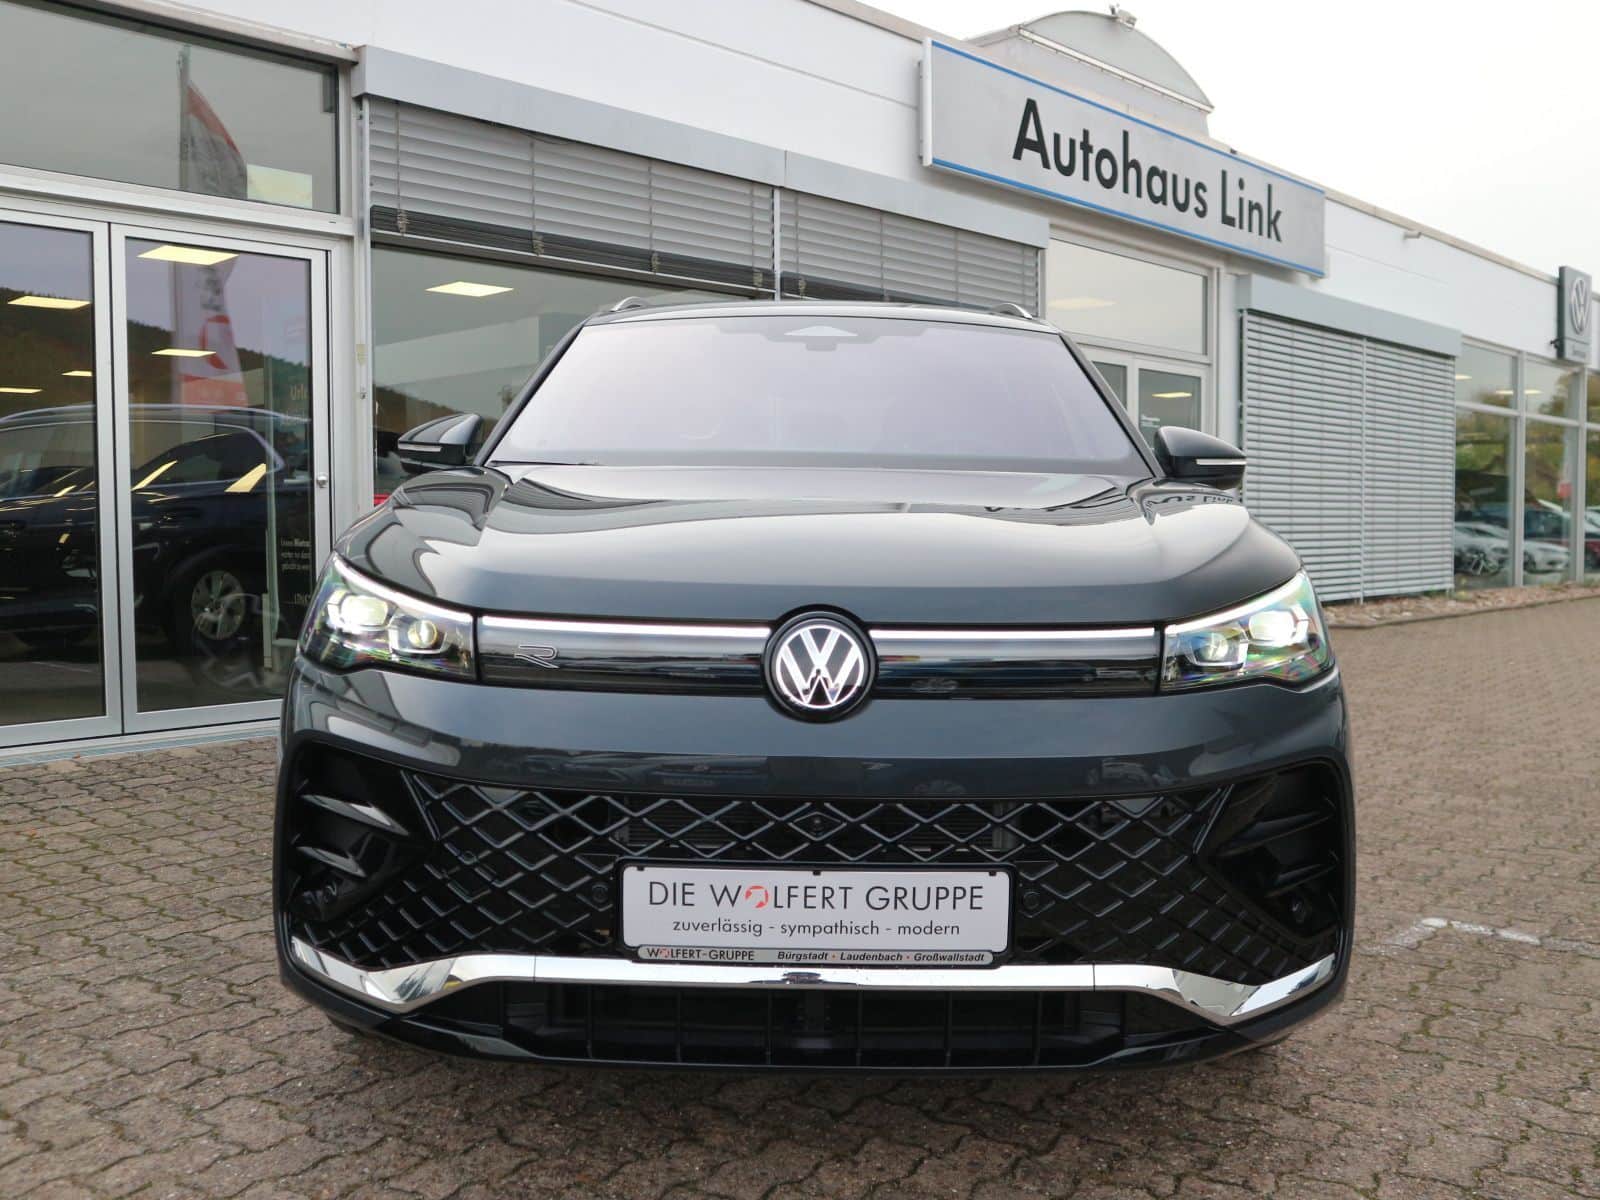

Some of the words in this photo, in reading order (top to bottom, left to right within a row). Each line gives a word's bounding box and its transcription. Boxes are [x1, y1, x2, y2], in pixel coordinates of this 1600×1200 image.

[1012, 97, 1208, 219] Autohaus
[1220, 169, 1283, 243] Link
[514, 644, 559, 669] R
[776, 624, 865, 709] VW
[649, 881, 695, 907] DIE
[709, 884, 853, 910] WOLFERT
[865, 885, 984, 911] GRUPPE
[673, 917, 762, 937] zuverlässig
[780, 920, 879, 938] sympathisch
[897, 920, 960, 936] modern
[646, 948, 755, 961] WOLFERT-GRUPPE
[777, 950, 828, 961] Bürgstadt
[840, 951, 903, 962] Laudenbach
[913, 952, 985, 962] Großwallstadt
